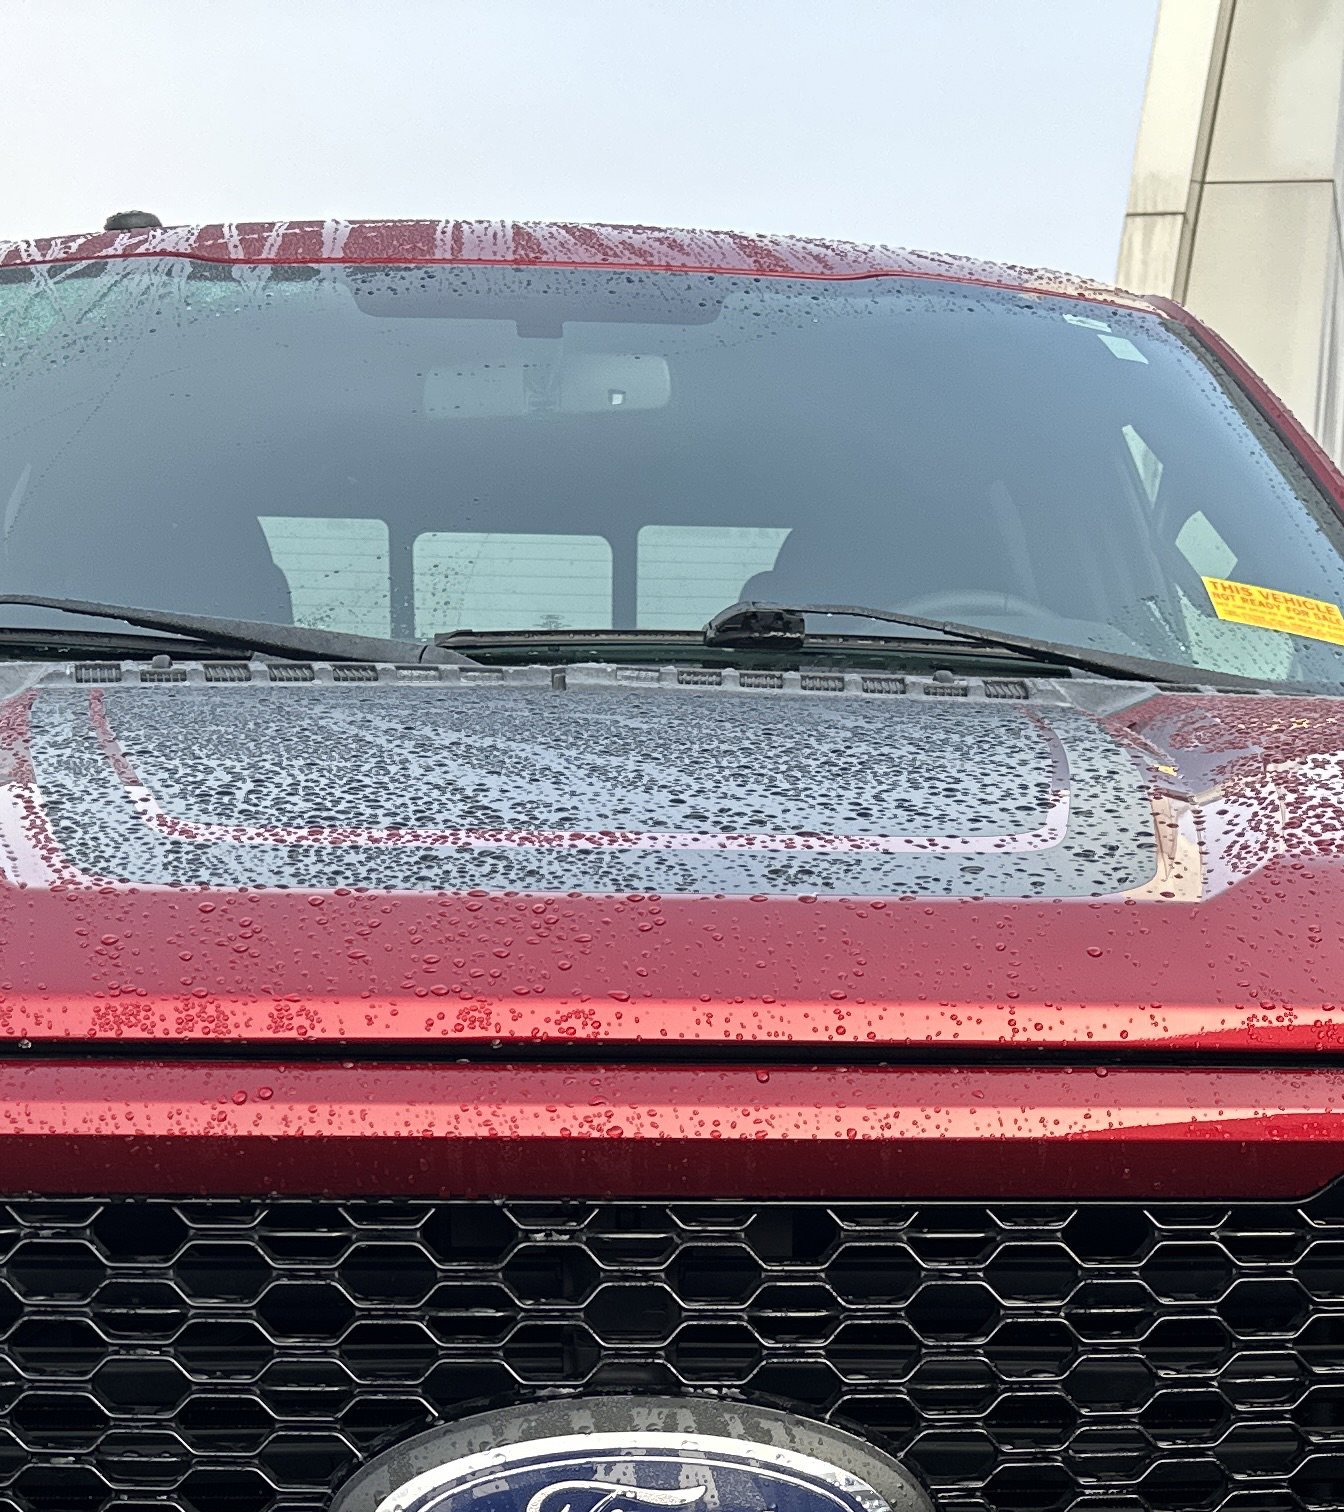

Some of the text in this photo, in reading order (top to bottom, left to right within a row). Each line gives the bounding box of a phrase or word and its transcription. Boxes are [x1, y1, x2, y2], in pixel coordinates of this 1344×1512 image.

[1209, 581, 1253, 597] THIS
[1257, 589, 1337, 617] VEHICLE
[1212, 592, 1236, 602] NOT
[1240, 597, 1281, 611] READY
[1285, 606, 1310, 618] FOR
[1313, 612, 1342, 626] SALE
